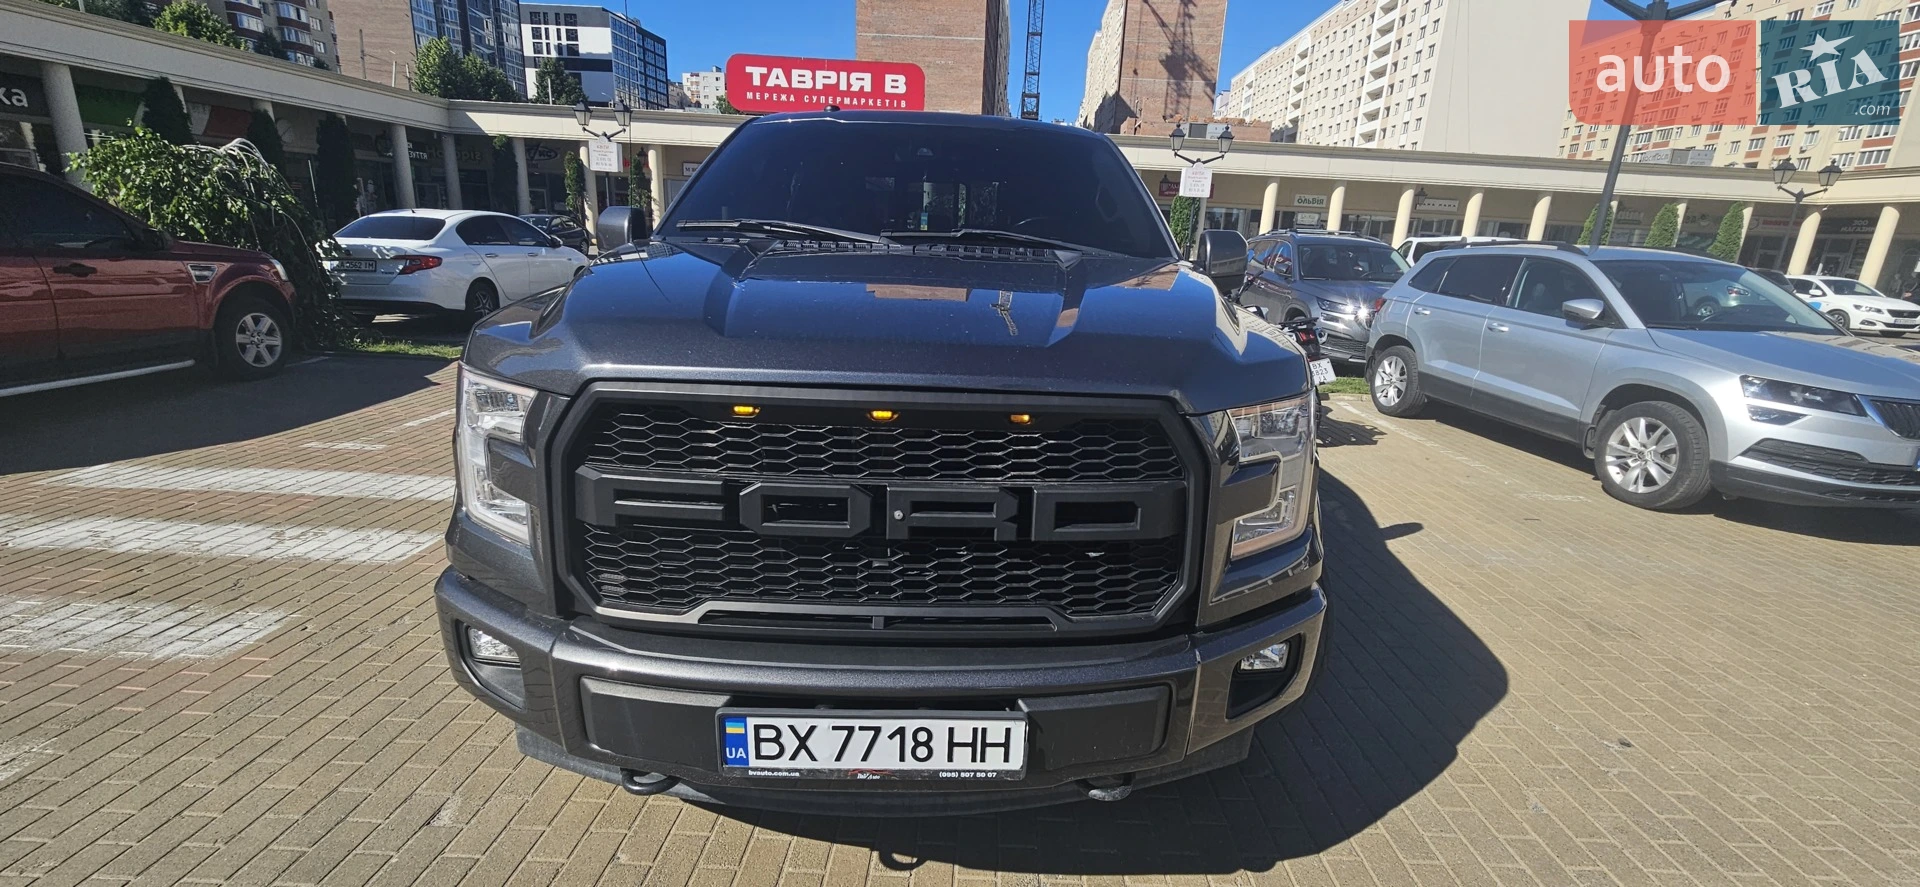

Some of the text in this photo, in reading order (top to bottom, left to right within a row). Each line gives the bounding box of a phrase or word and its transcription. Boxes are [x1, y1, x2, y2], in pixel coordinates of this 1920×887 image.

[745, 66, 907, 94] ТАВРІЯ В
[746, 92, 906, 108] МЕРЕЖА СУПЕРМАРКЕТІВ
[576, 466, 1187, 541] FORD
[726, 747, 747, 759] UA
[753, 723, 1012, 764] BX 7718 HH
[748, 769, 800, 777] bvauto.com.ua
